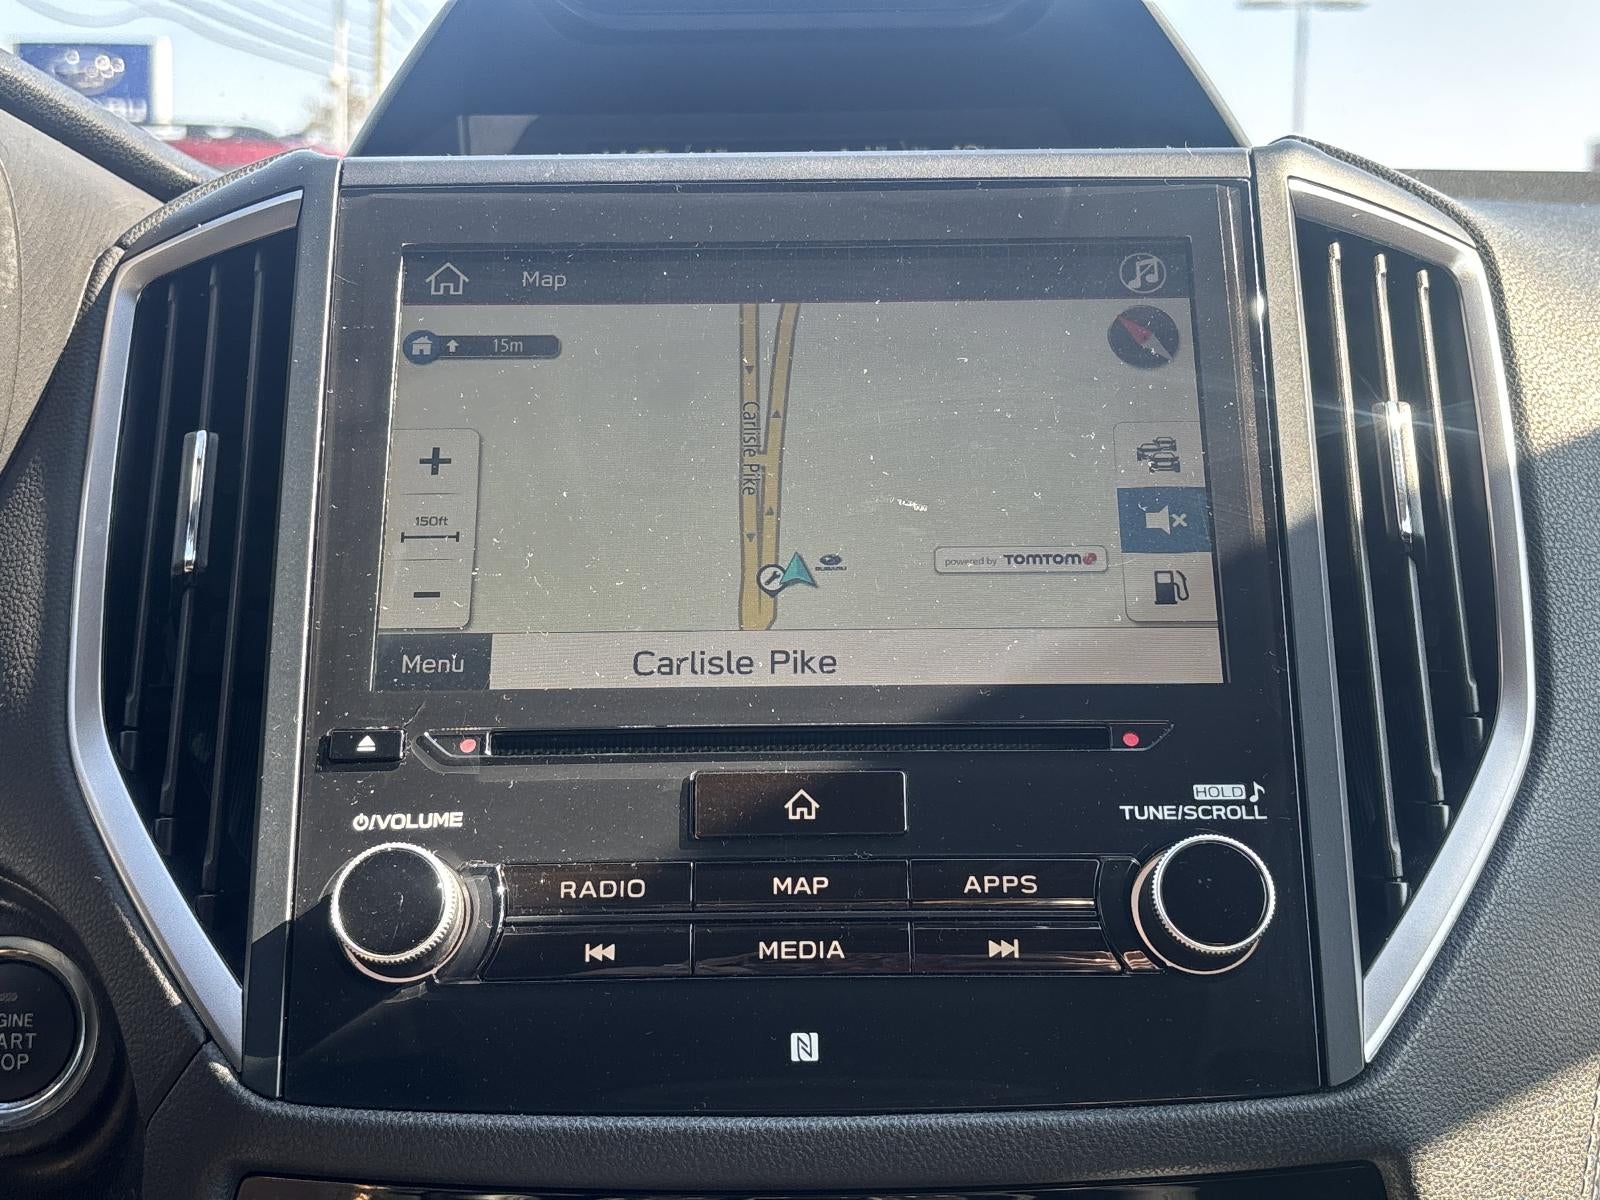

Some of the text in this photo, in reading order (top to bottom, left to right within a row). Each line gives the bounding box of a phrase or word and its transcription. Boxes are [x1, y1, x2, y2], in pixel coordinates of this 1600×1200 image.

[522, 271, 567, 291] Map
[493, 338, 523, 353] 15m
[742, 401, 762, 496] Carlisle Pike
[414, 515, 449, 528] 150ft
[944, 557, 985, 566] powered
[986, 557, 997, 567] by
[401, 654, 465, 674] Menu
[632, 650, 837, 676] Carlisle Pike
[1195, 784, 1245, 799] HOLD
[1119, 805, 1268, 821] TUNE/SCROLL
[559, 879, 647, 899] RADIO
[772, 876, 830, 895] MAP
[963, 875, 1038, 894] APPS
[758, 941, 846, 959] MEDIA
